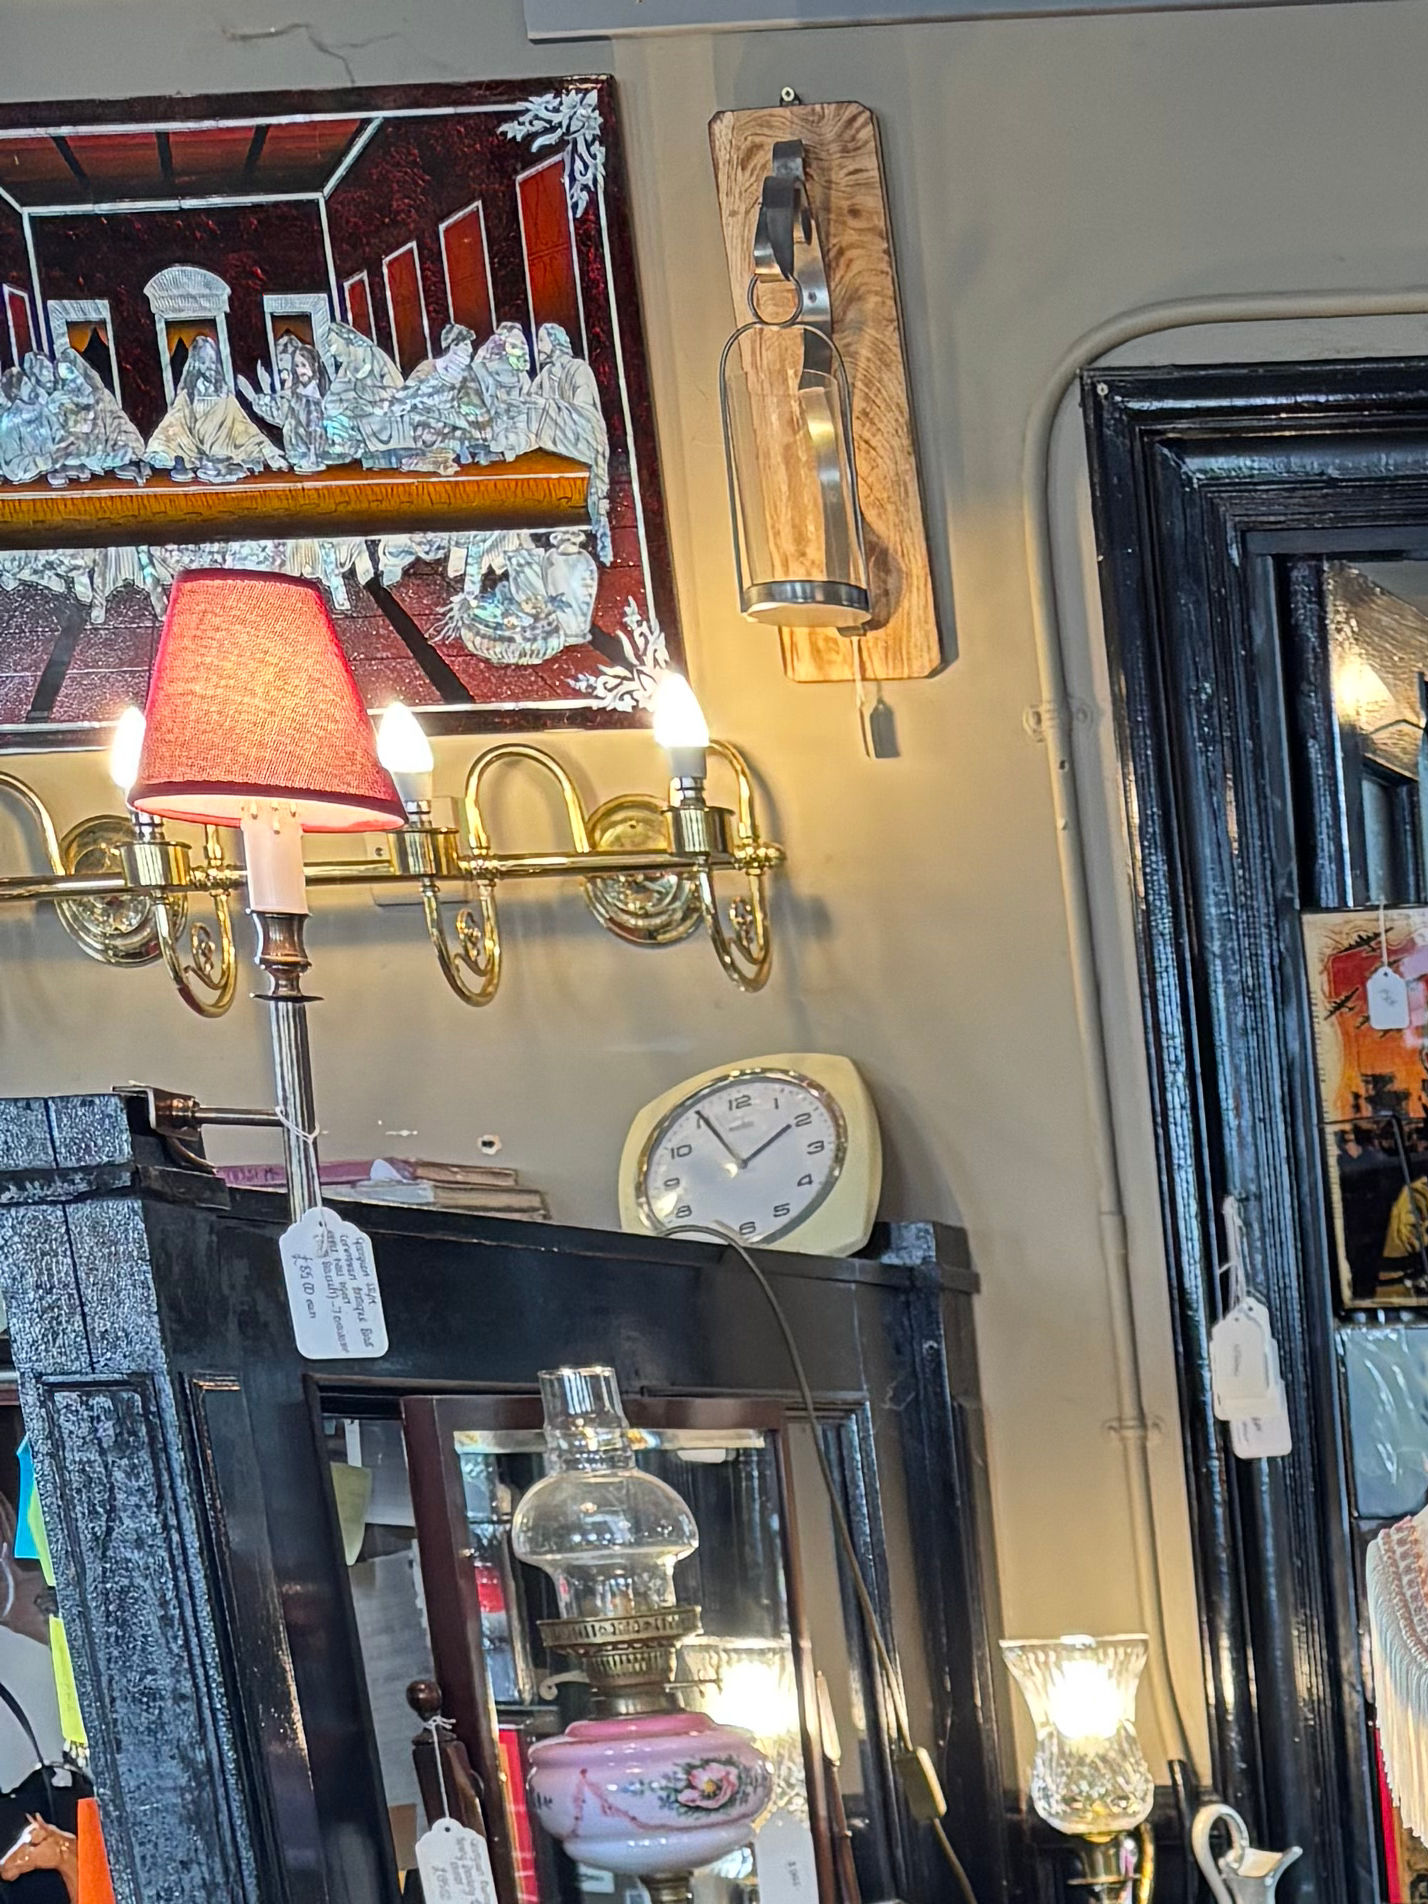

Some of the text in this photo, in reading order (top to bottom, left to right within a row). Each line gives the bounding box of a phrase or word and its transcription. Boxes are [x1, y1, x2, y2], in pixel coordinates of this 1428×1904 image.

[728, 1094, 753, 1111] 12
[773, 1098, 780, 1111] 1
[794, 1112, 813, 1128] 2
[670, 1144, 693, 1160] 10
[807, 1140, 826, 1155] 3
[663, 1177, 681, 1191] 9
[796, 1173, 814, 1187] 4
[675, 1204, 693, 1219] 8
[772, 1202, 791, 1218] 5
[738, 1221, 757, 1236] 6
